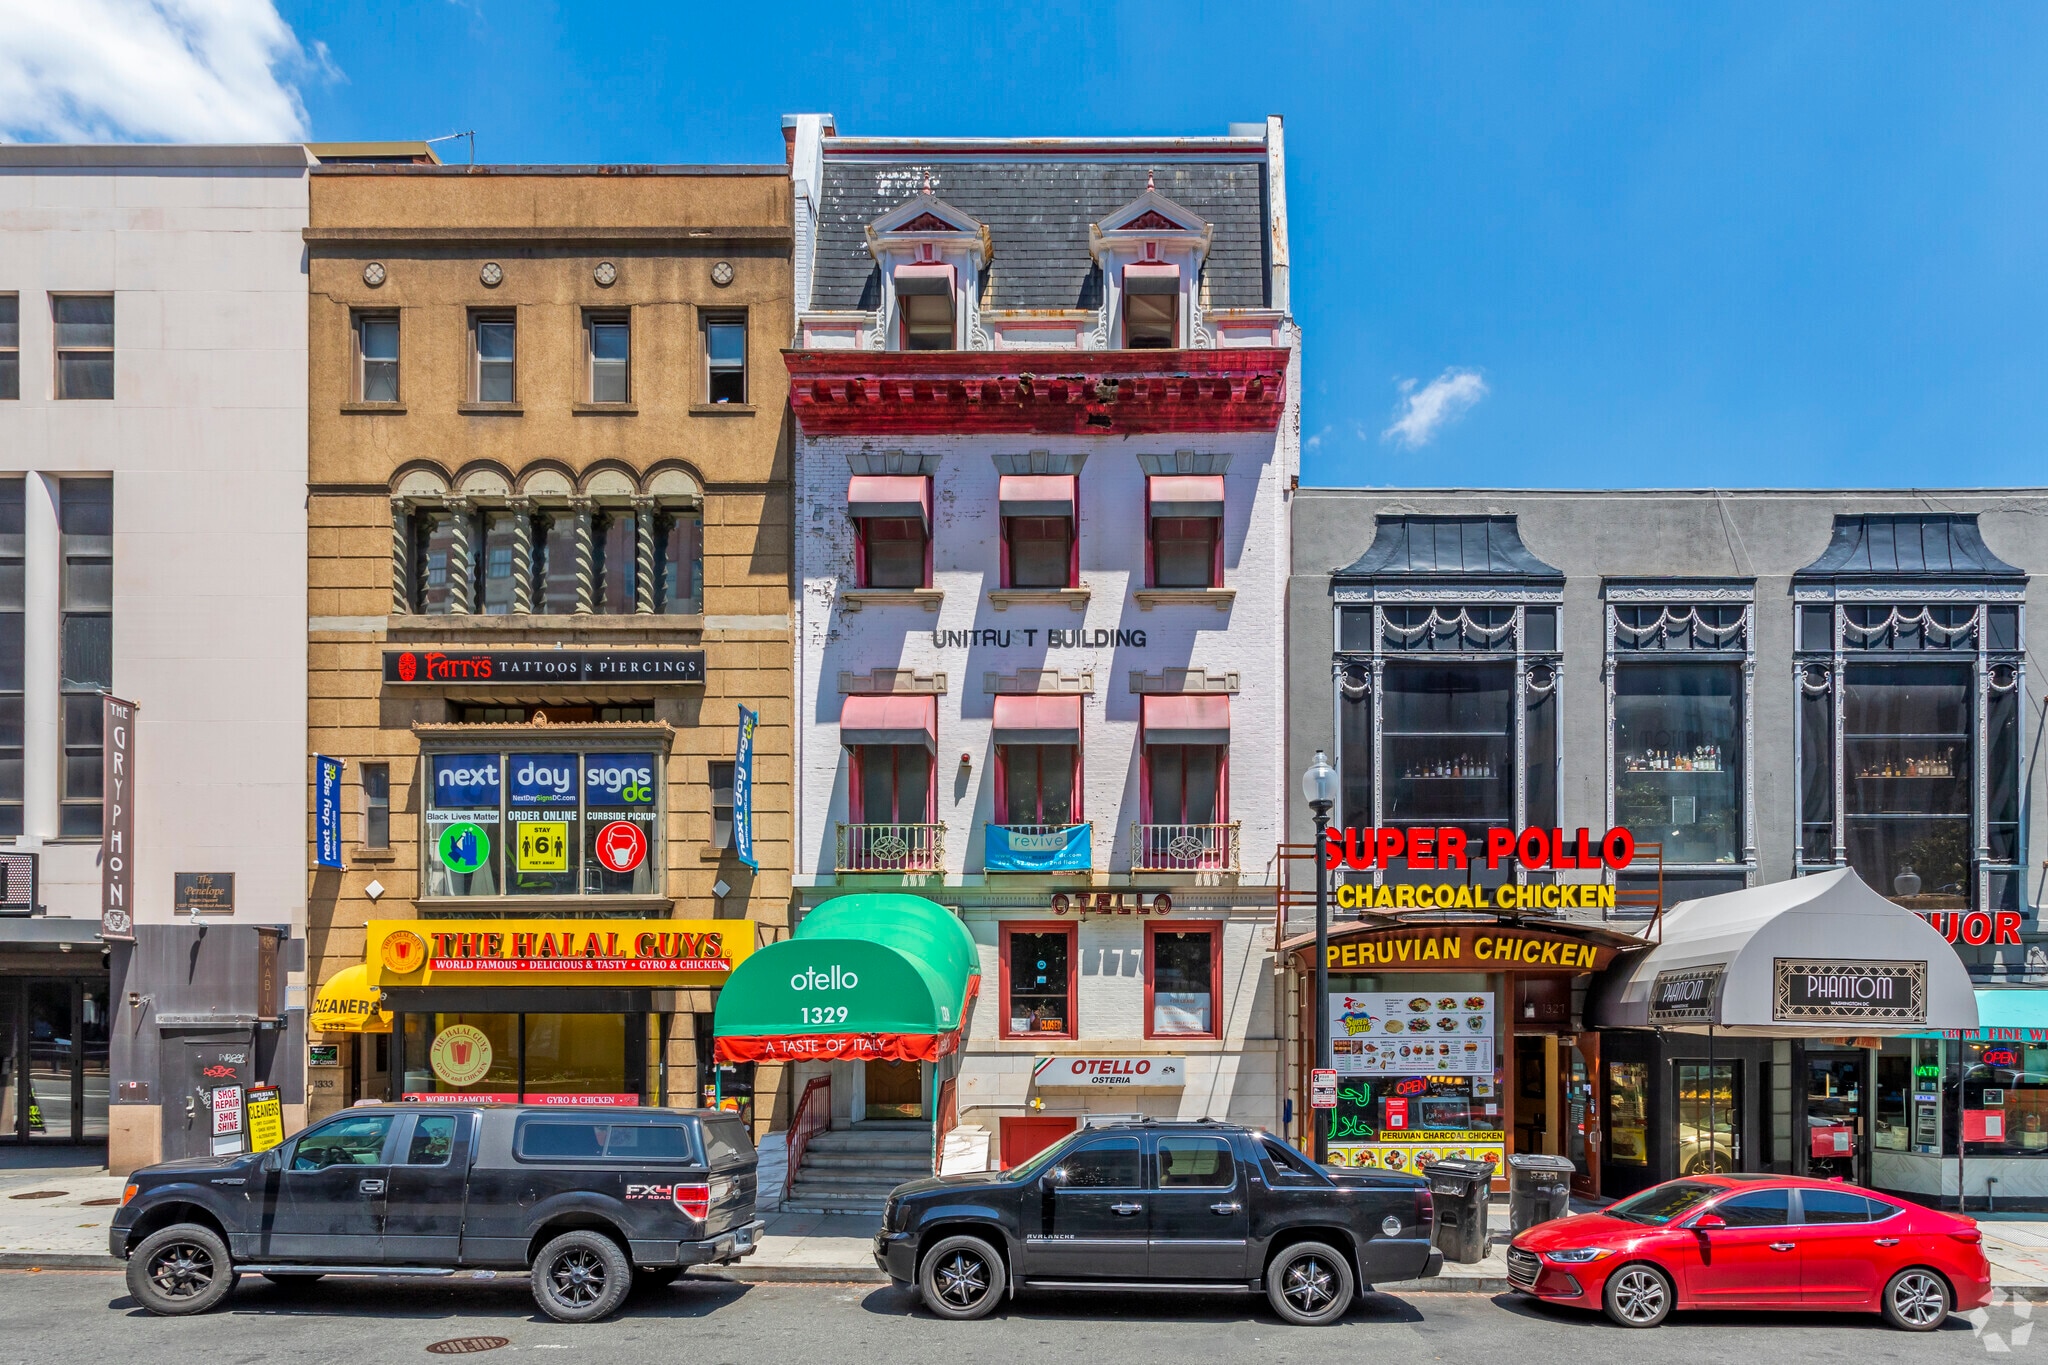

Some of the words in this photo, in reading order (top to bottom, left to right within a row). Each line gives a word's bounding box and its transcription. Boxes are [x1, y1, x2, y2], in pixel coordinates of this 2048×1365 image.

[1048, 628, 1147, 649] BUILDING
[499, 660, 577, 674] TATTOOS
[584, 663, 592, 672] &
[599, 660, 696, 673] PIERCINGS
[110, 703, 129, 720] THE
[739, 715, 749, 763] signs
[323, 763, 332, 796] signs
[329, 765, 336, 780] dc
[438, 764, 500, 787] next
[518, 761, 570, 793] day
[587, 768, 651, 793] signs
[622, 781, 652, 802] dc
[735, 766, 747, 806] day
[512, 794, 576, 803] NextDaySignsDC.com
[110, 726, 126, 907] GRYPHON
[322, 799, 332, 826] day
[427, 813, 449, 821] Black
[451, 813, 471, 821] Lives
[473, 813, 499, 821] Matter
[508, 811, 540, 821] ORDER
[543, 811, 577, 821] ONLINE
[587, 812, 626, 821] CURBSIDE
[627, 812, 657, 821] PICKUP
[735, 811, 747, 856] next
[1014, 834, 1063, 847] revive
[322, 828, 331, 861] next
[535, 836, 550, 854] 6
[1315, 827, 1468, 870] SUPER
[1486, 826, 1635, 870] POLLO
[195, 875, 214, 884] The
[184, 886, 225, 898] Penelope
[1336, 884, 1490, 909] CHARCOAL
[1496, 884, 1616, 909] CHICKEN
[1051, 893, 1173, 915] OTELLO
[431, 932, 502, 959] THE
[511, 932, 624, 959] HALAL
[634, 932, 723, 959] GUYS
[1328, 937, 1462, 968] PERUVIAN
[1475, 937, 1598, 969] CHICKEN
[436, 960, 474, 970] WORLD
[475, 960, 518, 970] FAMOUS
[529, 960, 583, 970] DELICIOUS
[585, 960, 593, 970] &
[595, 960, 628, 970] TASTY
[639, 960, 668, 970] GYRO
[669, 960, 677, 970] &
[680, 960, 725, 970] CHICKEN
[790, 965, 859, 991] otello
[1663, 978, 1704, 1003] PHANTOM
[1807, 975, 1893, 999] PHANTOM
[313, 998, 382, 1016] CLEANERS
[800, 1006, 849, 1024] 1329
[322, 1022, 346, 1031] 1333
[1041, 1020, 1062, 1031] CLOSED
[433, 1037, 446, 1053] THE
[446, 1027, 471, 1037] HALAL
[472, 1032, 489, 1053] GUYS
[1989, 1029, 2023, 1041] FINE
[765, 1041, 776, 1053] A
[780, 1040, 819, 1053] TASTE
[825, 1039, 847, 1052] OF
[853, 1038, 887, 1052] ITALY
[1983, 1051, 2018, 1065] OPEN
[436, 1062, 451, 1078] GYRO
[463, 1062, 487, 1082] CHICKEN
[1071, 1059, 1151, 1075] OTELLO
[314, 1080, 334, 1088] 1333
[1091, 1076, 1131, 1084] OSTERIA
[1396, 1078, 1427, 1095] OPEN
[217, 1089, 237, 1100] SHOE
[425, 1095, 456, 1104] WORLD
[457, 1095, 493, 1104] FAMOUS
[546, 1095, 569, 1104] GYRO
[570, 1096, 577, 1104] &
[579, 1095, 615, 1104] CHICKEN
[215, 1099, 240, 1110] REPAIR
[248, 1103, 279, 1120] CLEANERS
[219, 1111, 238, 1122] SHOE
[217, 1121, 239, 1132] SHINE
[1382, 1131, 1422, 1140] PERUVIAN
[1423, 1131, 1466, 1140] CHARCOAL
[1468, 1131, 1503, 1140] CHICKEN
[626, 1184, 672, 1195] FX4
